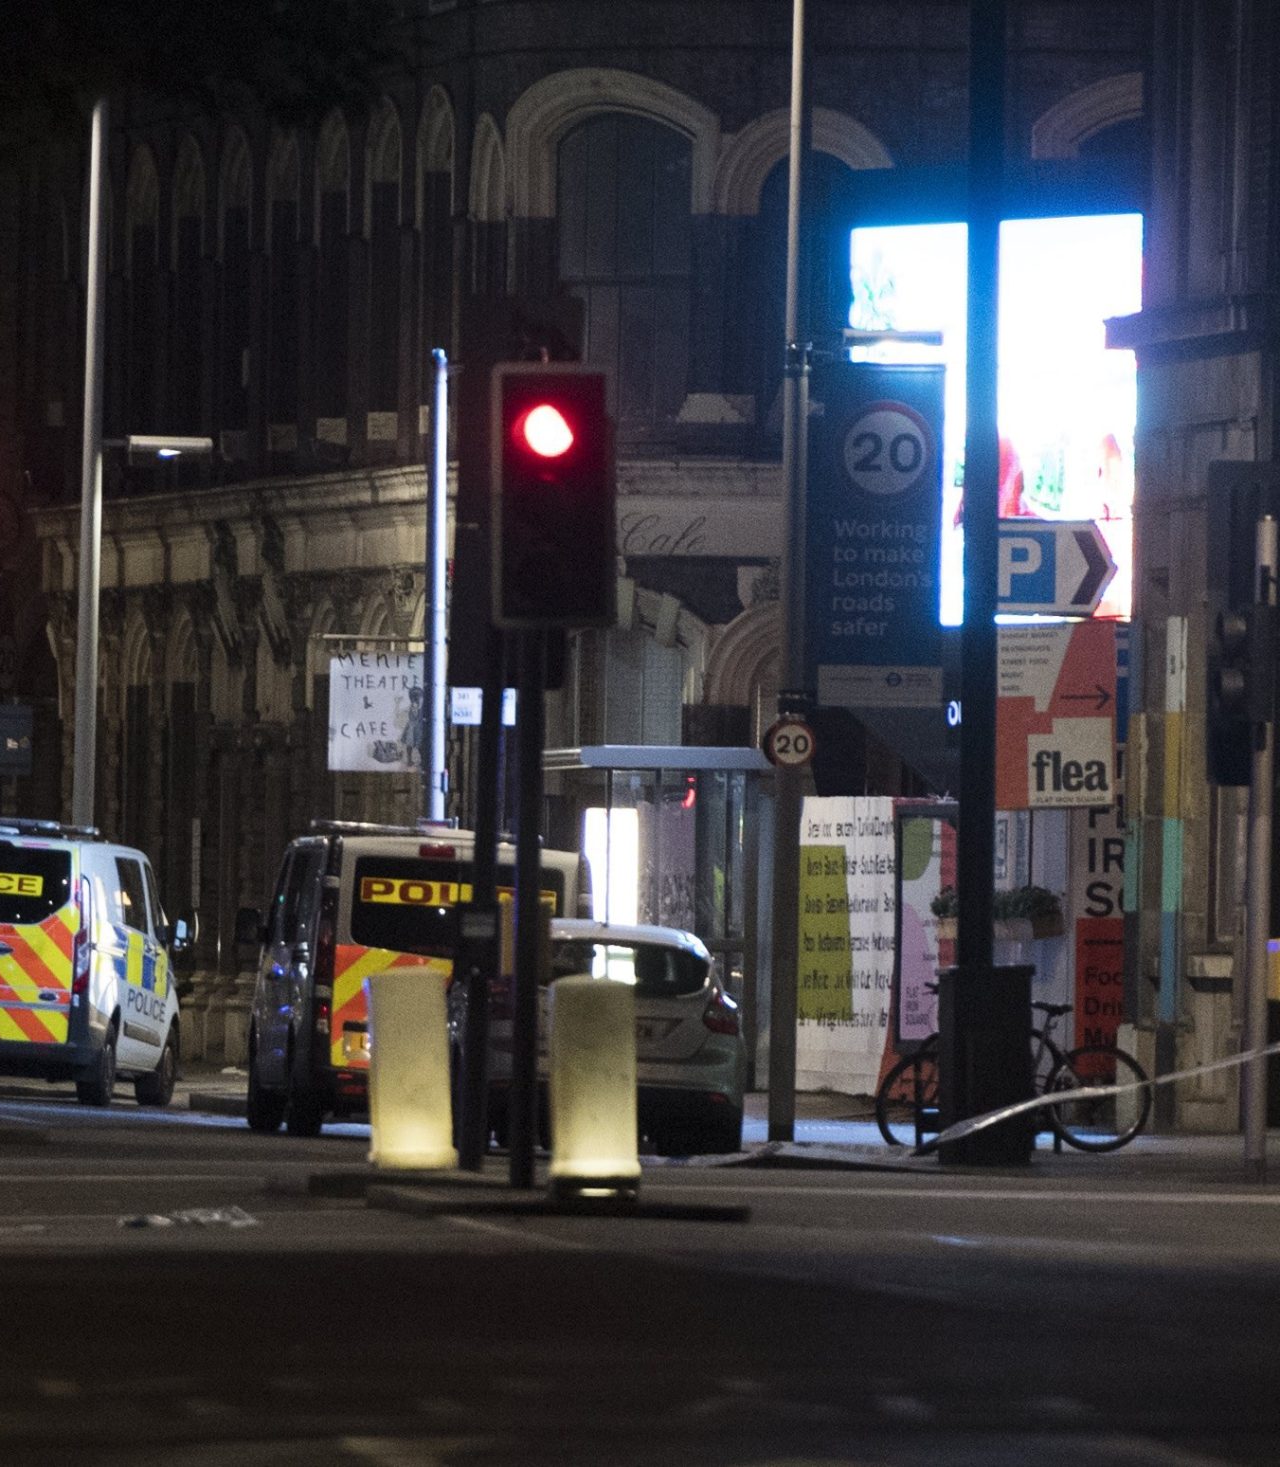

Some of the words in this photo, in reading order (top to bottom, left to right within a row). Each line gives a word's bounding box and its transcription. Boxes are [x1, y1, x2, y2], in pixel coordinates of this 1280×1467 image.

[853, 432, 923, 474] 20
[833, 518, 929, 543] Working
[833, 546, 858, 563] to
[864, 545, 925, 563] make
[998, 537, 1043, 597] P
[832, 592, 896, 612] roads
[831, 616, 889, 636] safer
[341, 674, 421, 691] THEATRE
[340, 721, 388, 739] CAFE
[776, 733, 809, 755] 20
[1032, 750, 1109, 792] flea
[127, 988, 166, 1024] POLICE
